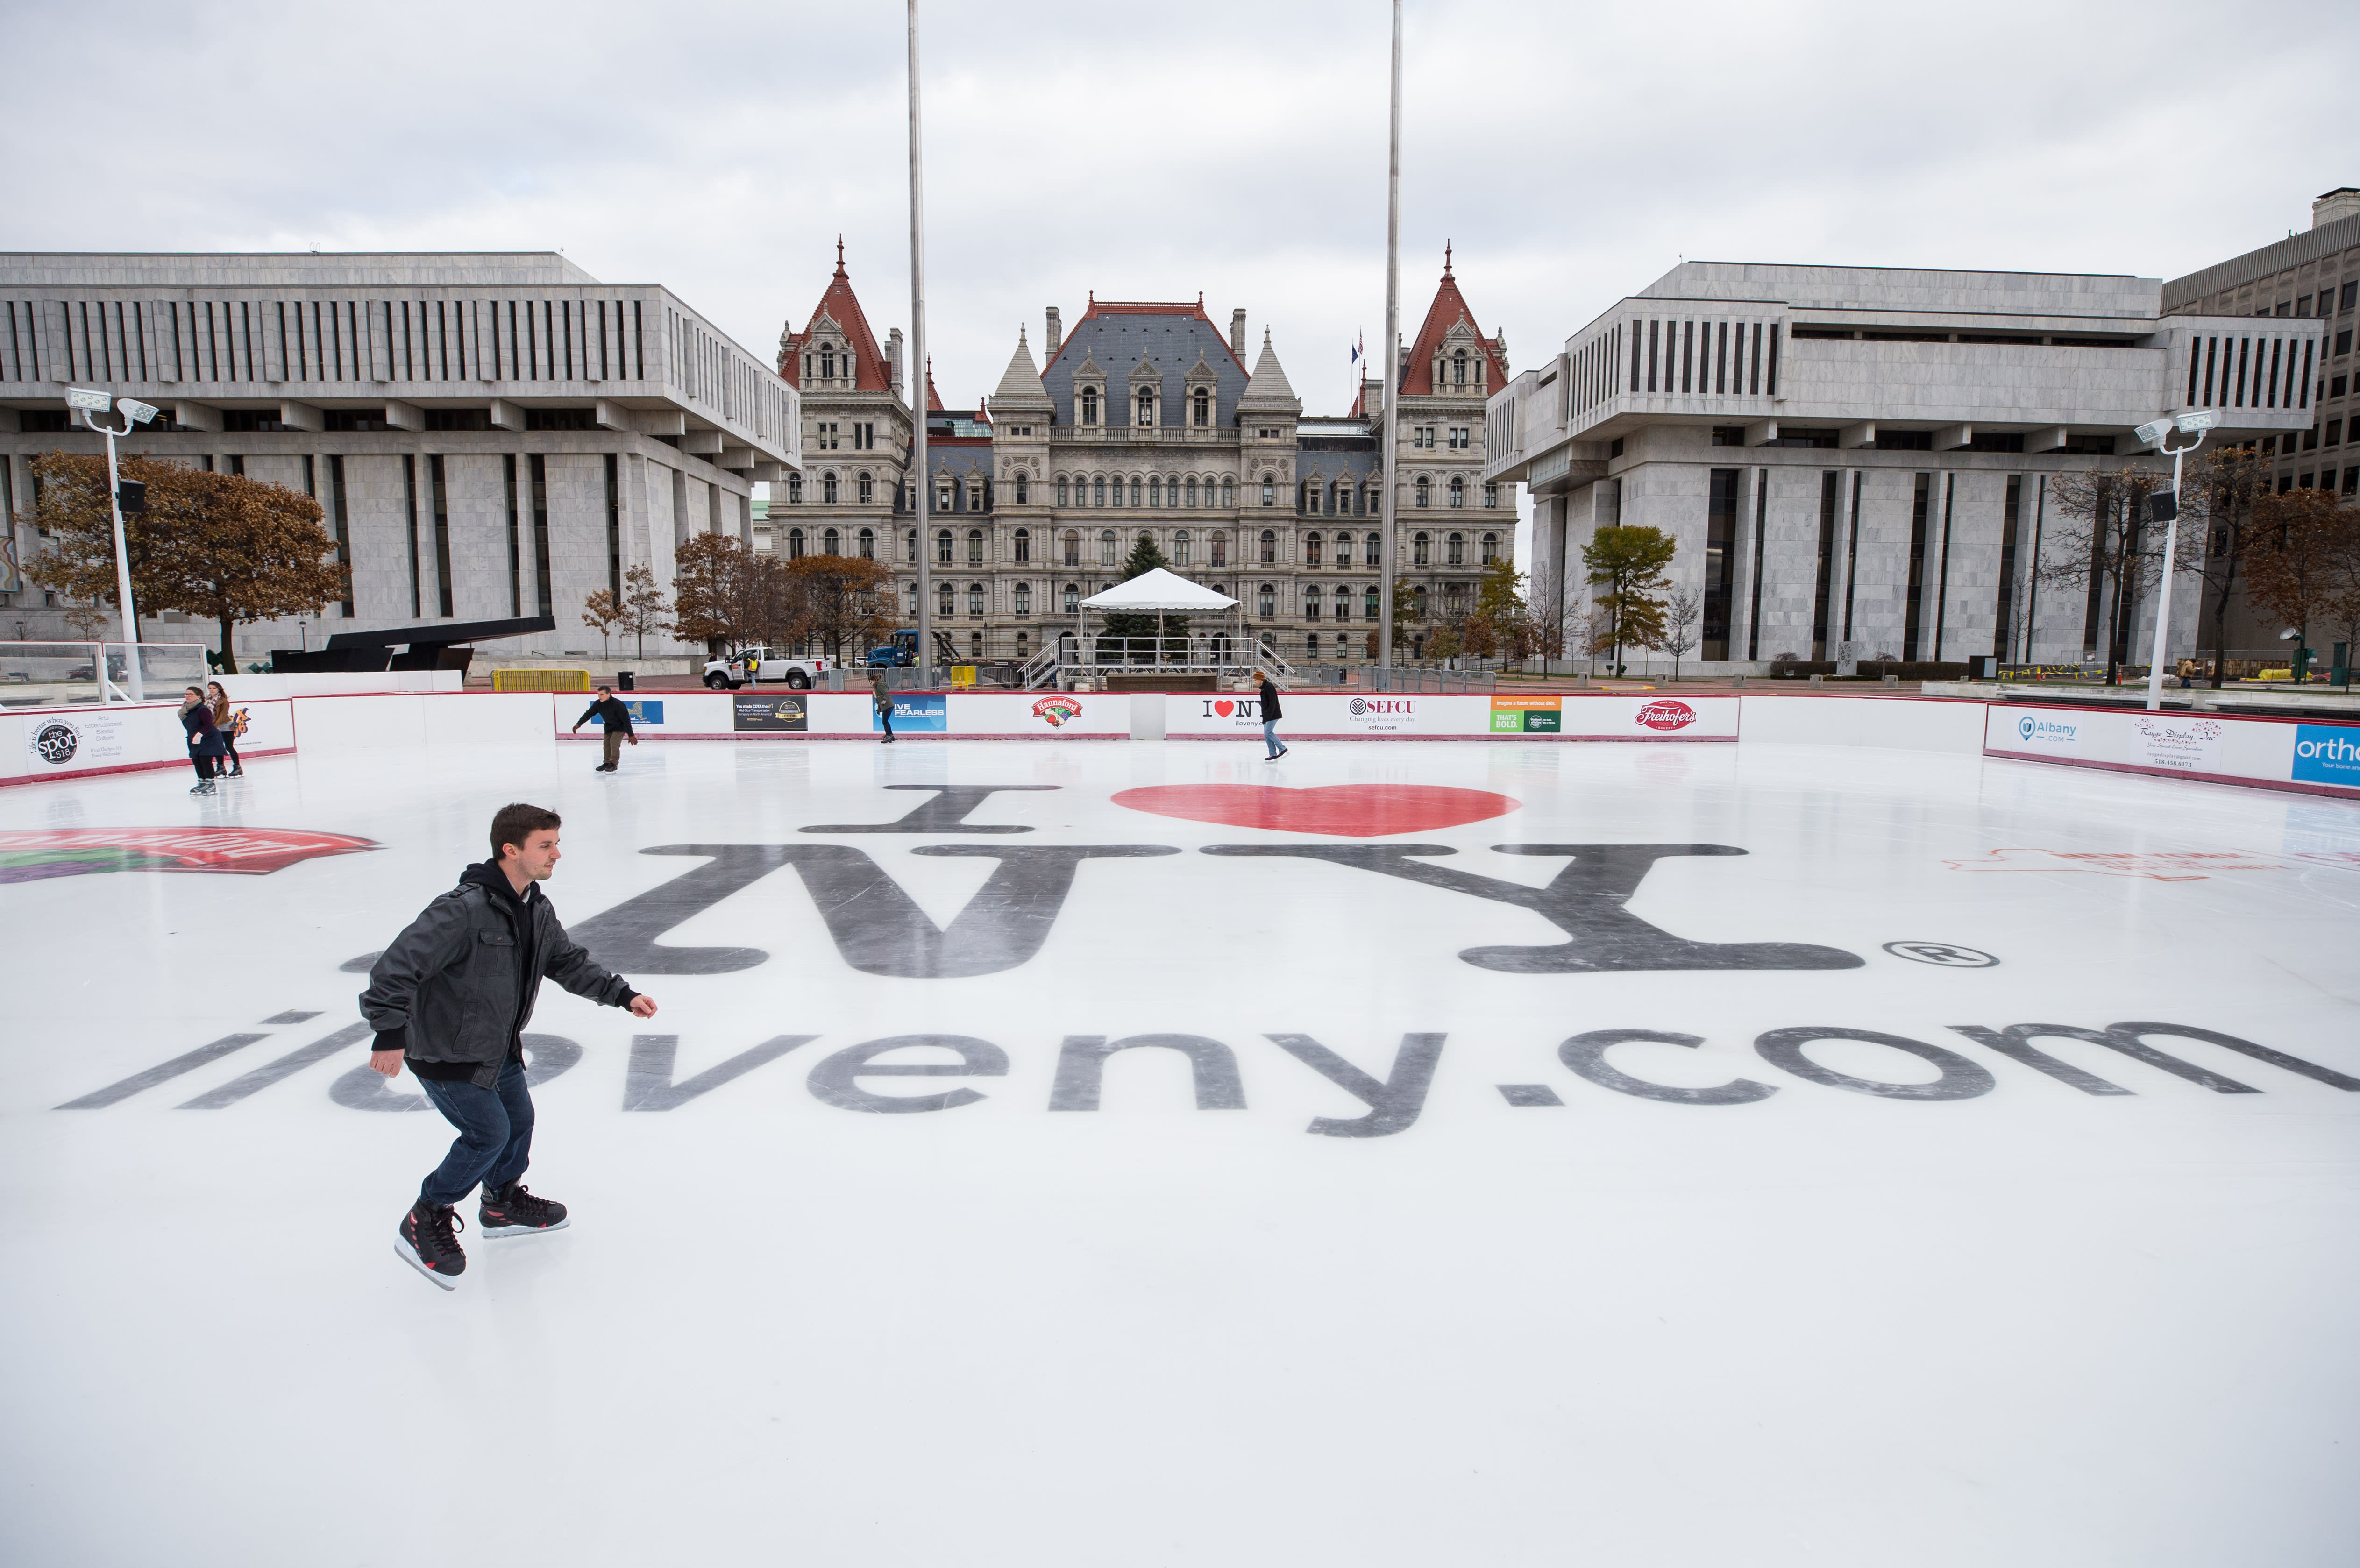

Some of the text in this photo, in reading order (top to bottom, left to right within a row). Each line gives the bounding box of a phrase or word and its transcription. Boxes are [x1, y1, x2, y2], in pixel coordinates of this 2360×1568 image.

[1036, 699, 1078, 711] Hannaford
[1203, 700, 1212, 717] I
[1367, 701, 1416, 713] SEFCU
[1635, 705, 1696, 726] Freihofer's
[31, 721, 46, 736] better
[63, 720, 74, 729] you
[73, 726, 84, 738] find
[48, 731, 63, 739] the
[2037, 722, 2076, 737] Albany
[2141, 727, 2162, 738] Rayge
[2199, 731, 2216, 741] Inc
[38, 732, 77, 759] spot
[2297, 738, 2360, 761] orth
[56, 748, 71, 759] 518
[2154, 759, 2192, 767] 518.458.6173
[797, 784, 1063, 833] I
